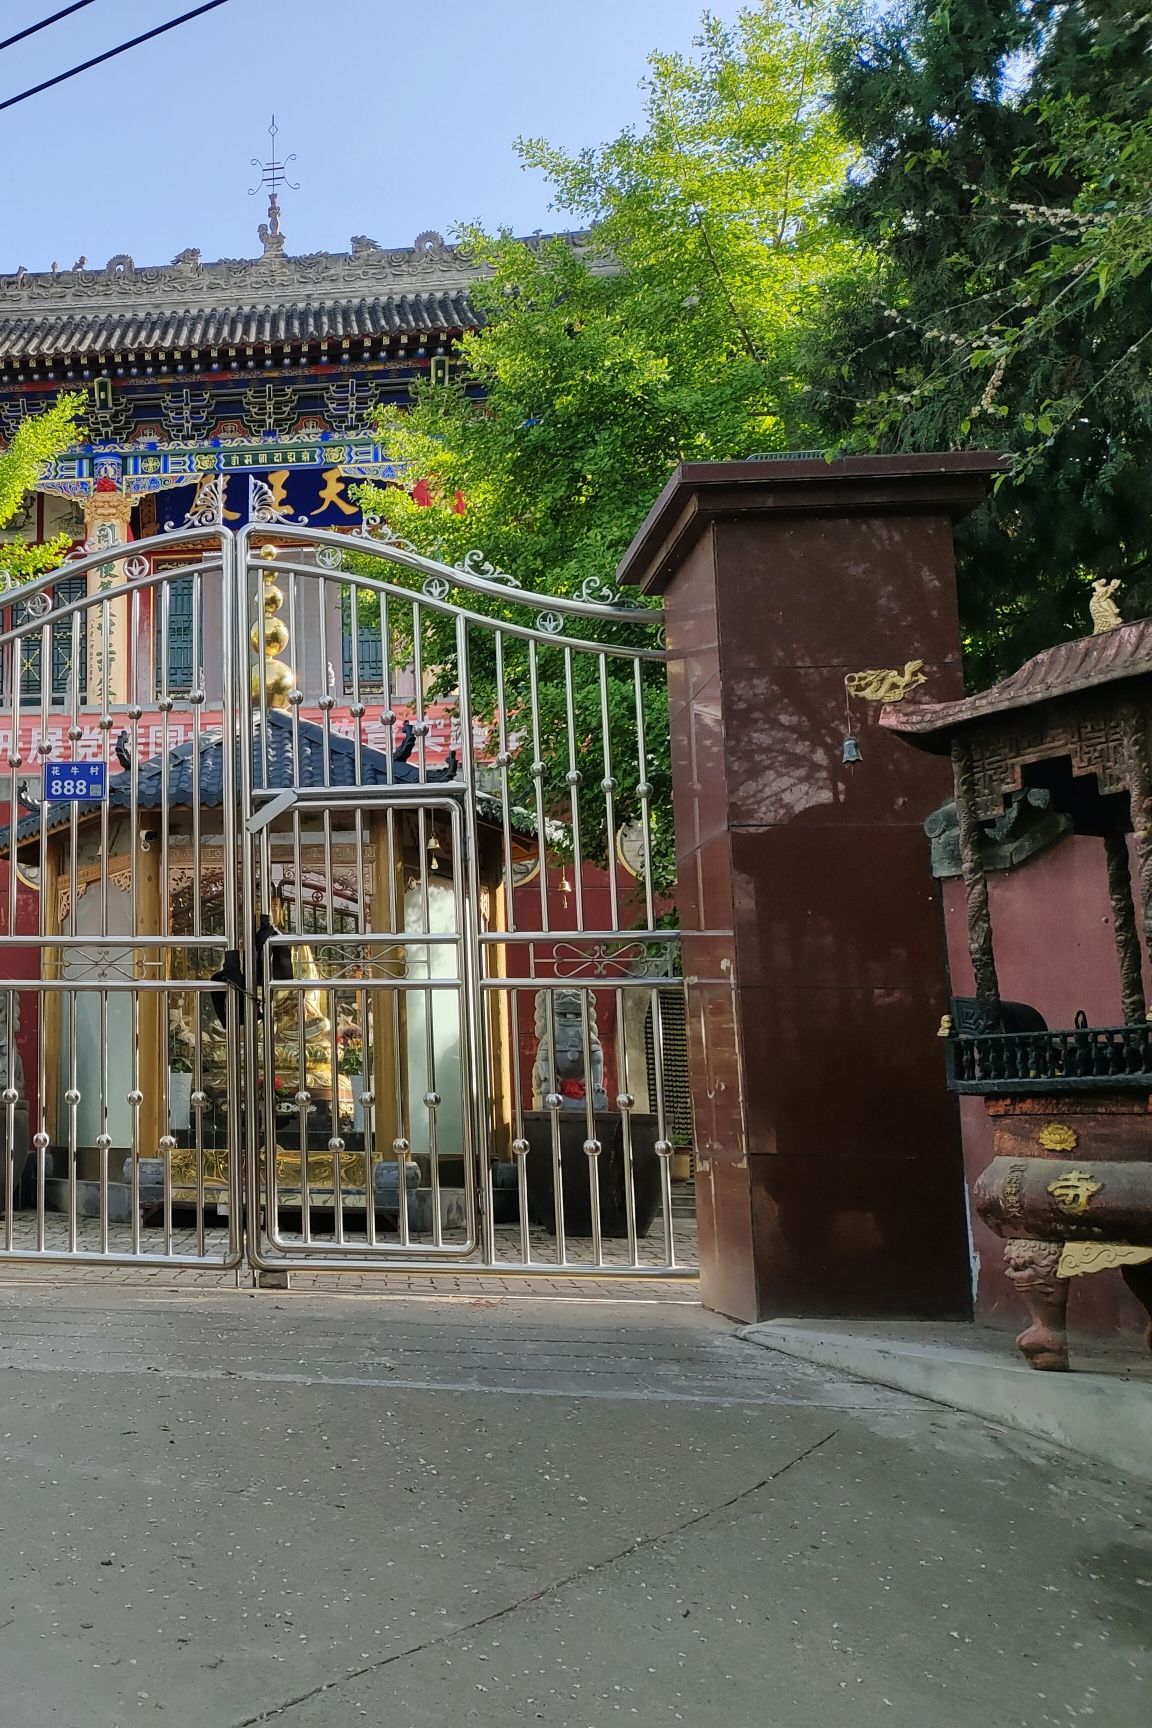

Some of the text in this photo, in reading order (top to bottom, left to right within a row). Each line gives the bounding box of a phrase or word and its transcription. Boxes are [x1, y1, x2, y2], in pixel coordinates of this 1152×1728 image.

[51, 766, 99, 776] 花牛村
[51, 780, 87, 795] 888
[1047, 1168, 1104, 1216] 寺
